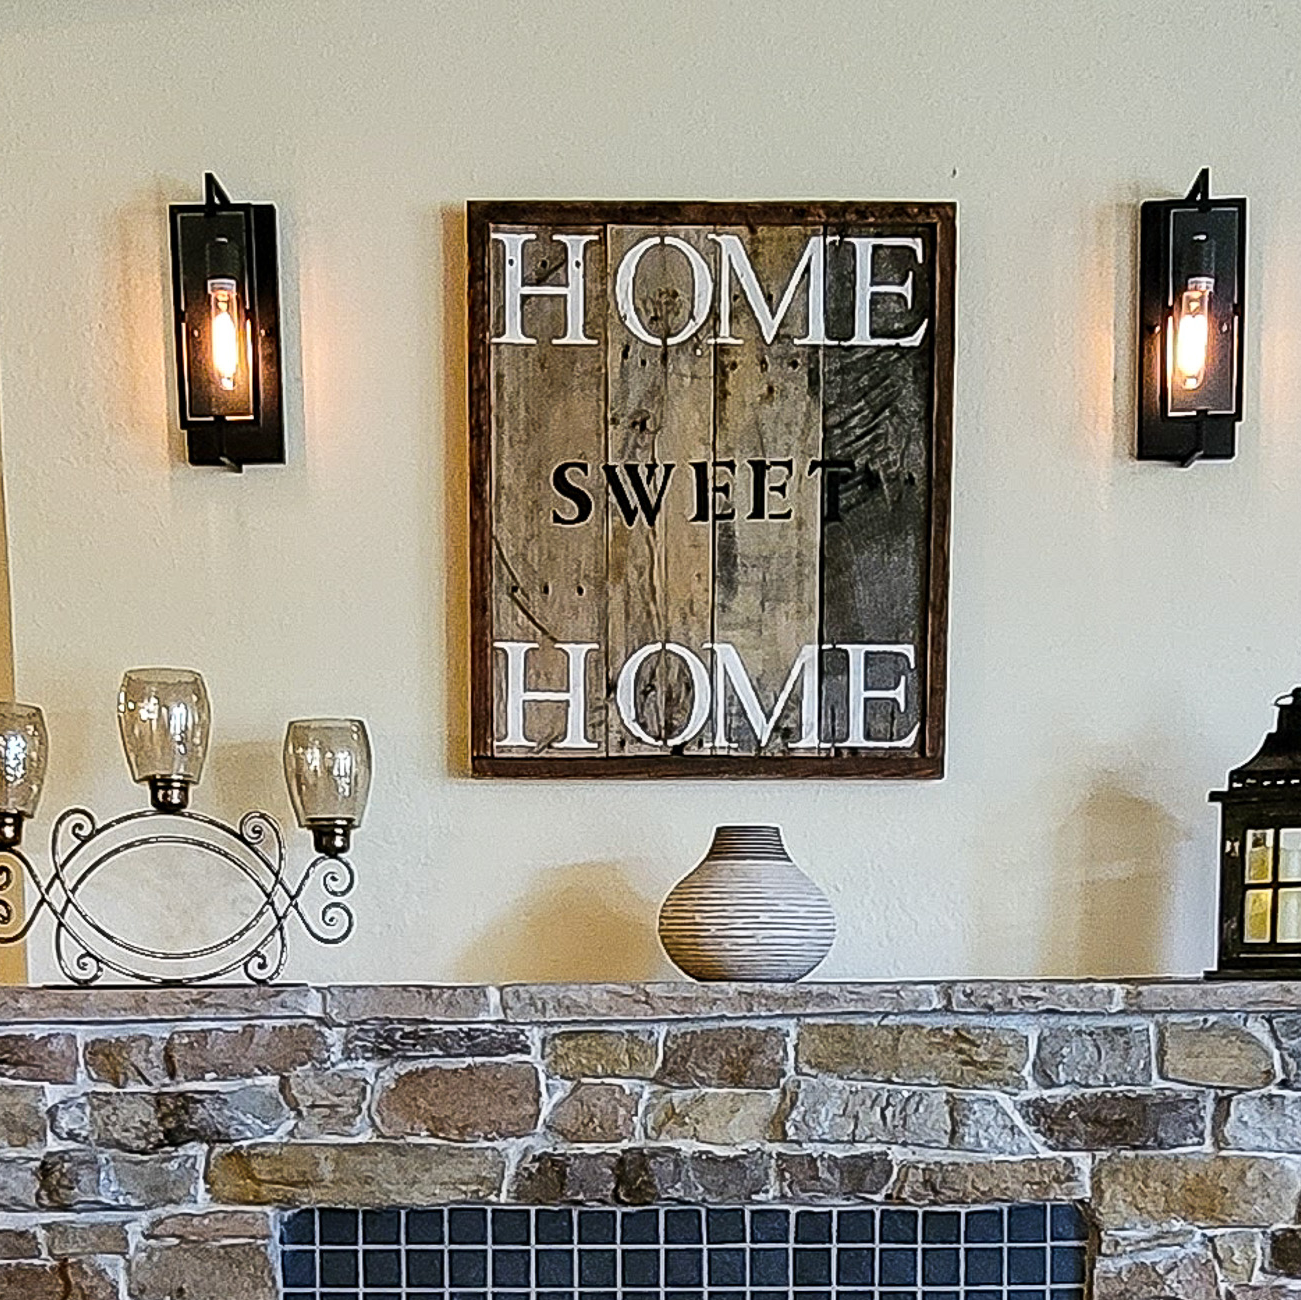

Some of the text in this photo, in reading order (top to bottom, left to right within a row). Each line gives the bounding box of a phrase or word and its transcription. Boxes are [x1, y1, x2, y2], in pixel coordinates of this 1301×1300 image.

[490, 232, 929, 347] HOME
[552, 457, 855, 528] SWEET
[492, 640, 920, 750] HOME
